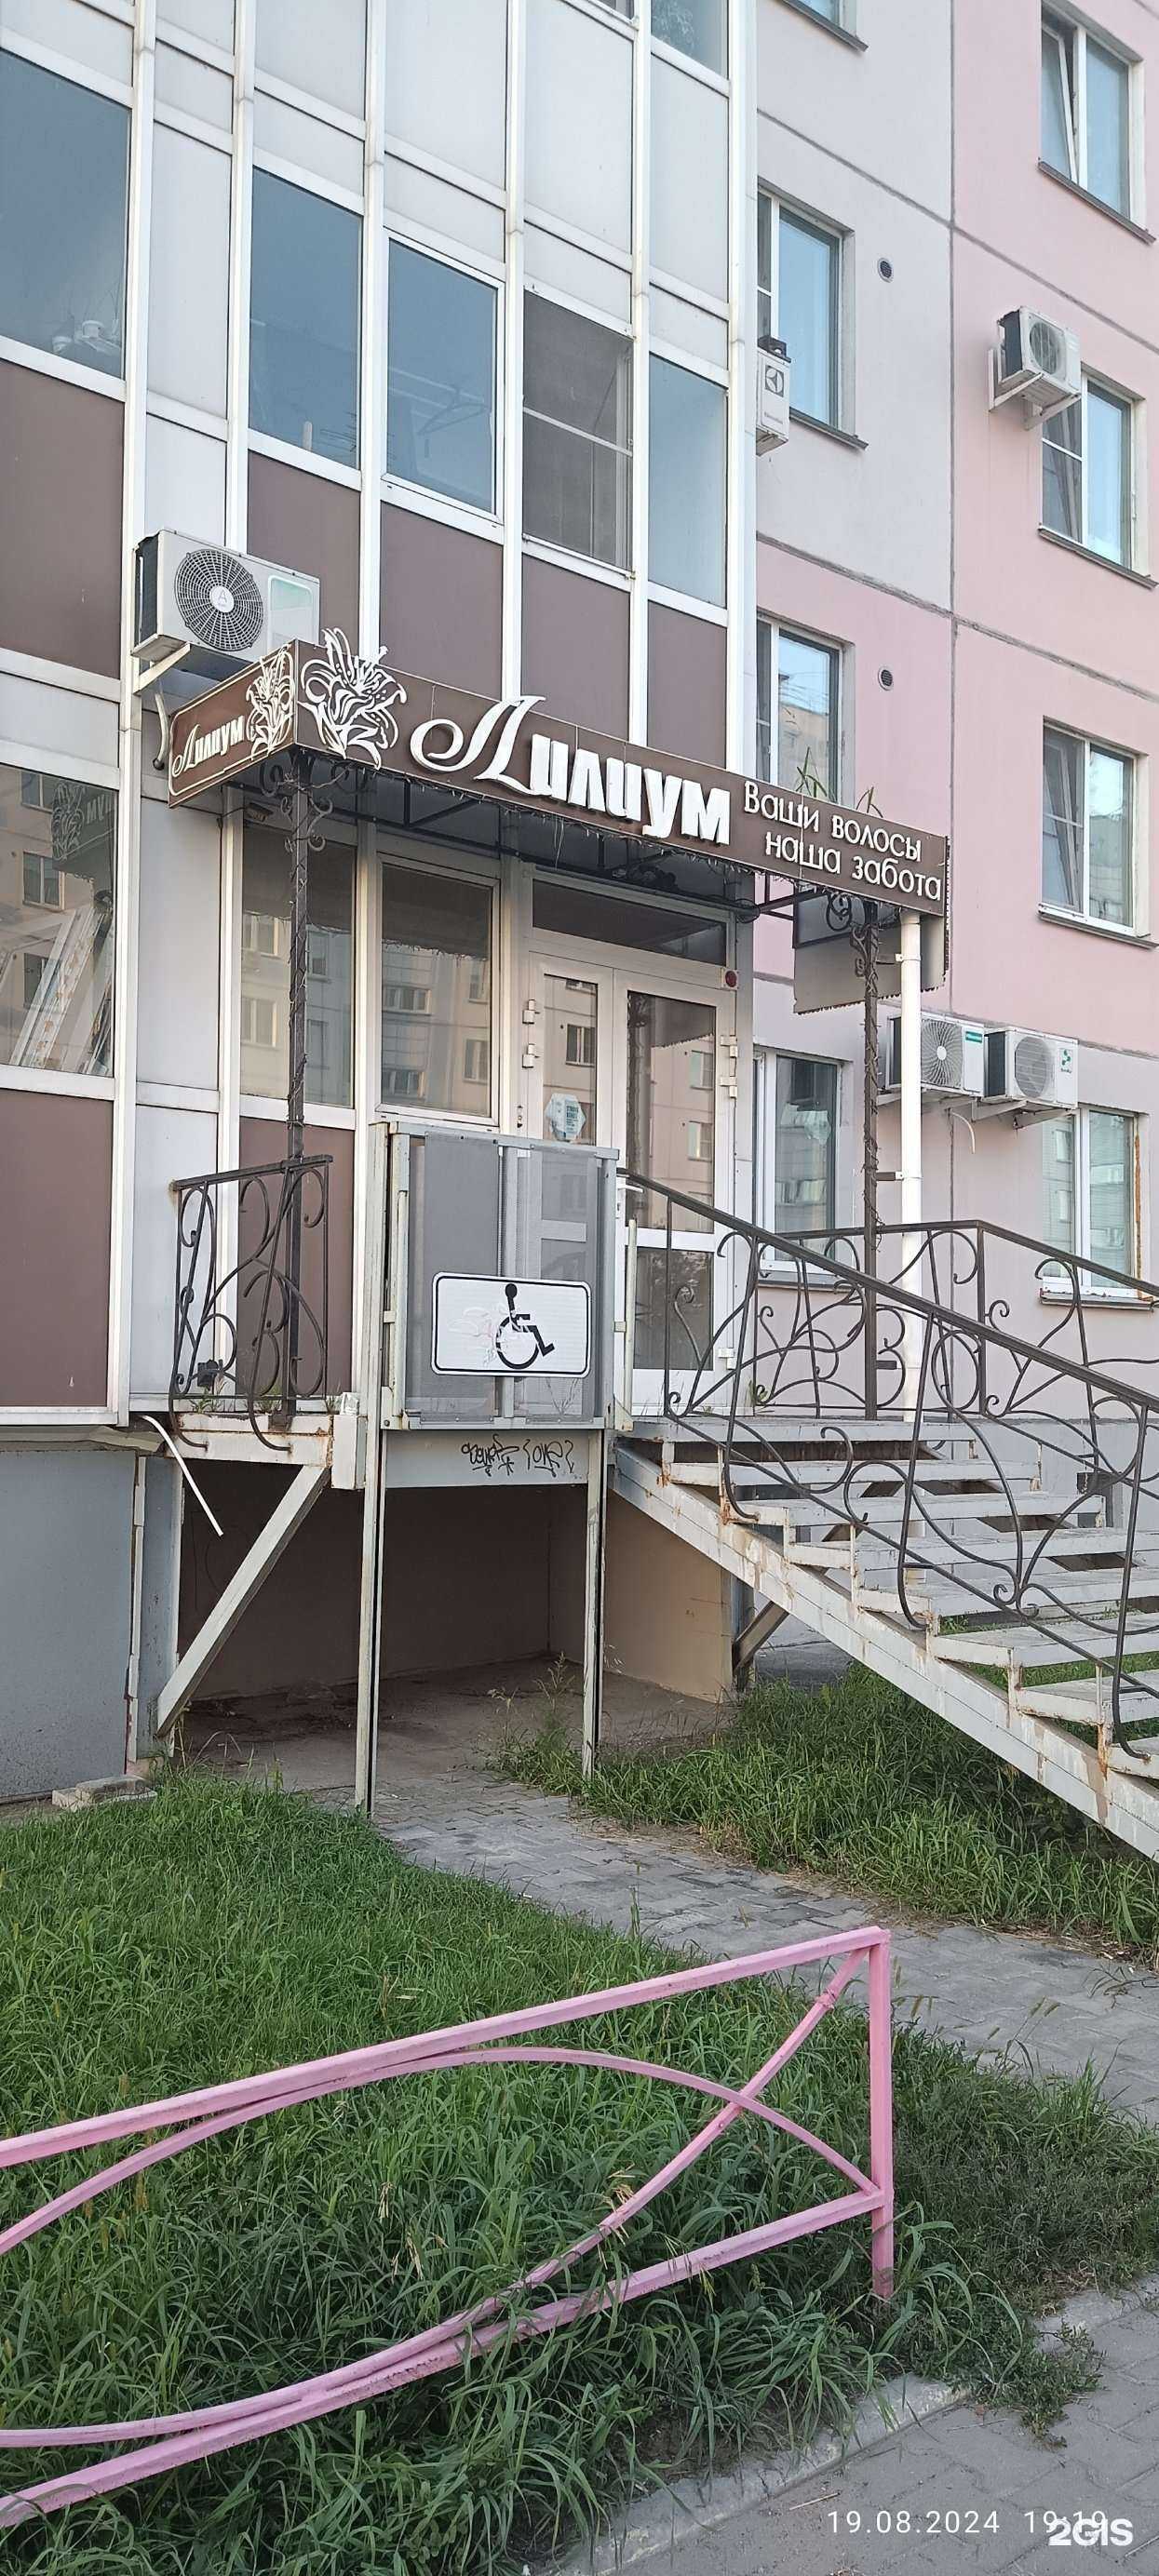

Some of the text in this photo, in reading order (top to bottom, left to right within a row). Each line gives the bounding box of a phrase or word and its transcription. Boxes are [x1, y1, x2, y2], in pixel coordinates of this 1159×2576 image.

[172, 715, 245, 778] Лилиум
[410, 695, 731, 846] Лилиум
[744, 780, 923, 863] Ваши волосы
[765, 831, 942, 902] наша забота
